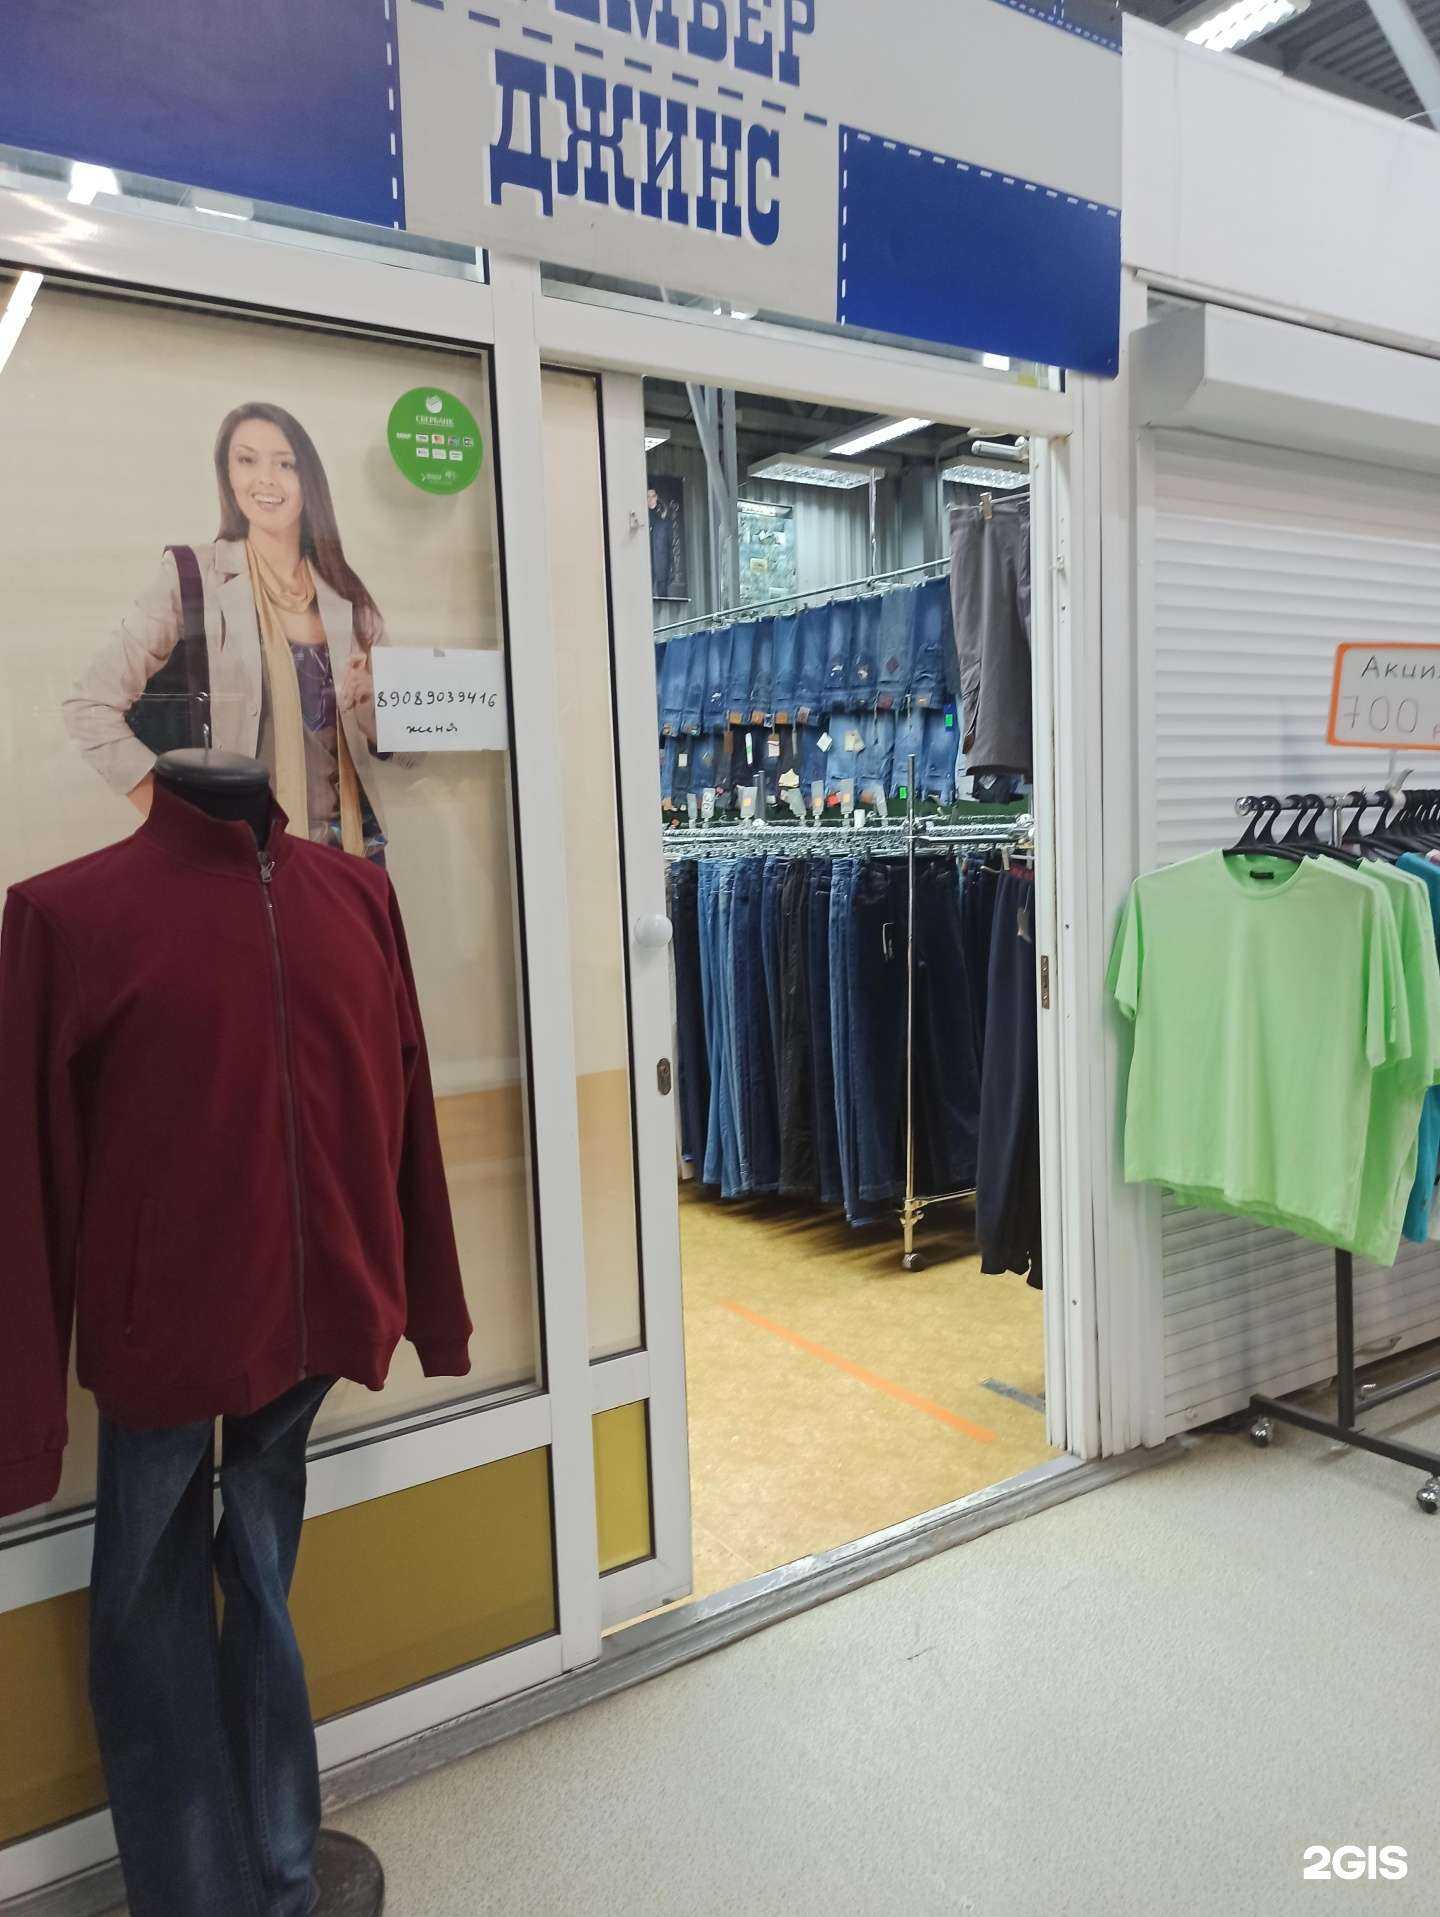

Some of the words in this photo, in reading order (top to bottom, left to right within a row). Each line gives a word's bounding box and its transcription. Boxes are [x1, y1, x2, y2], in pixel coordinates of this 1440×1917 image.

[490, 49, 780, 246] ДЖИНС
[1361, 655, 1440, 680] Акци
[377, 691, 498, 707] 89089039416
[1343, 695, 1419, 733] 700
